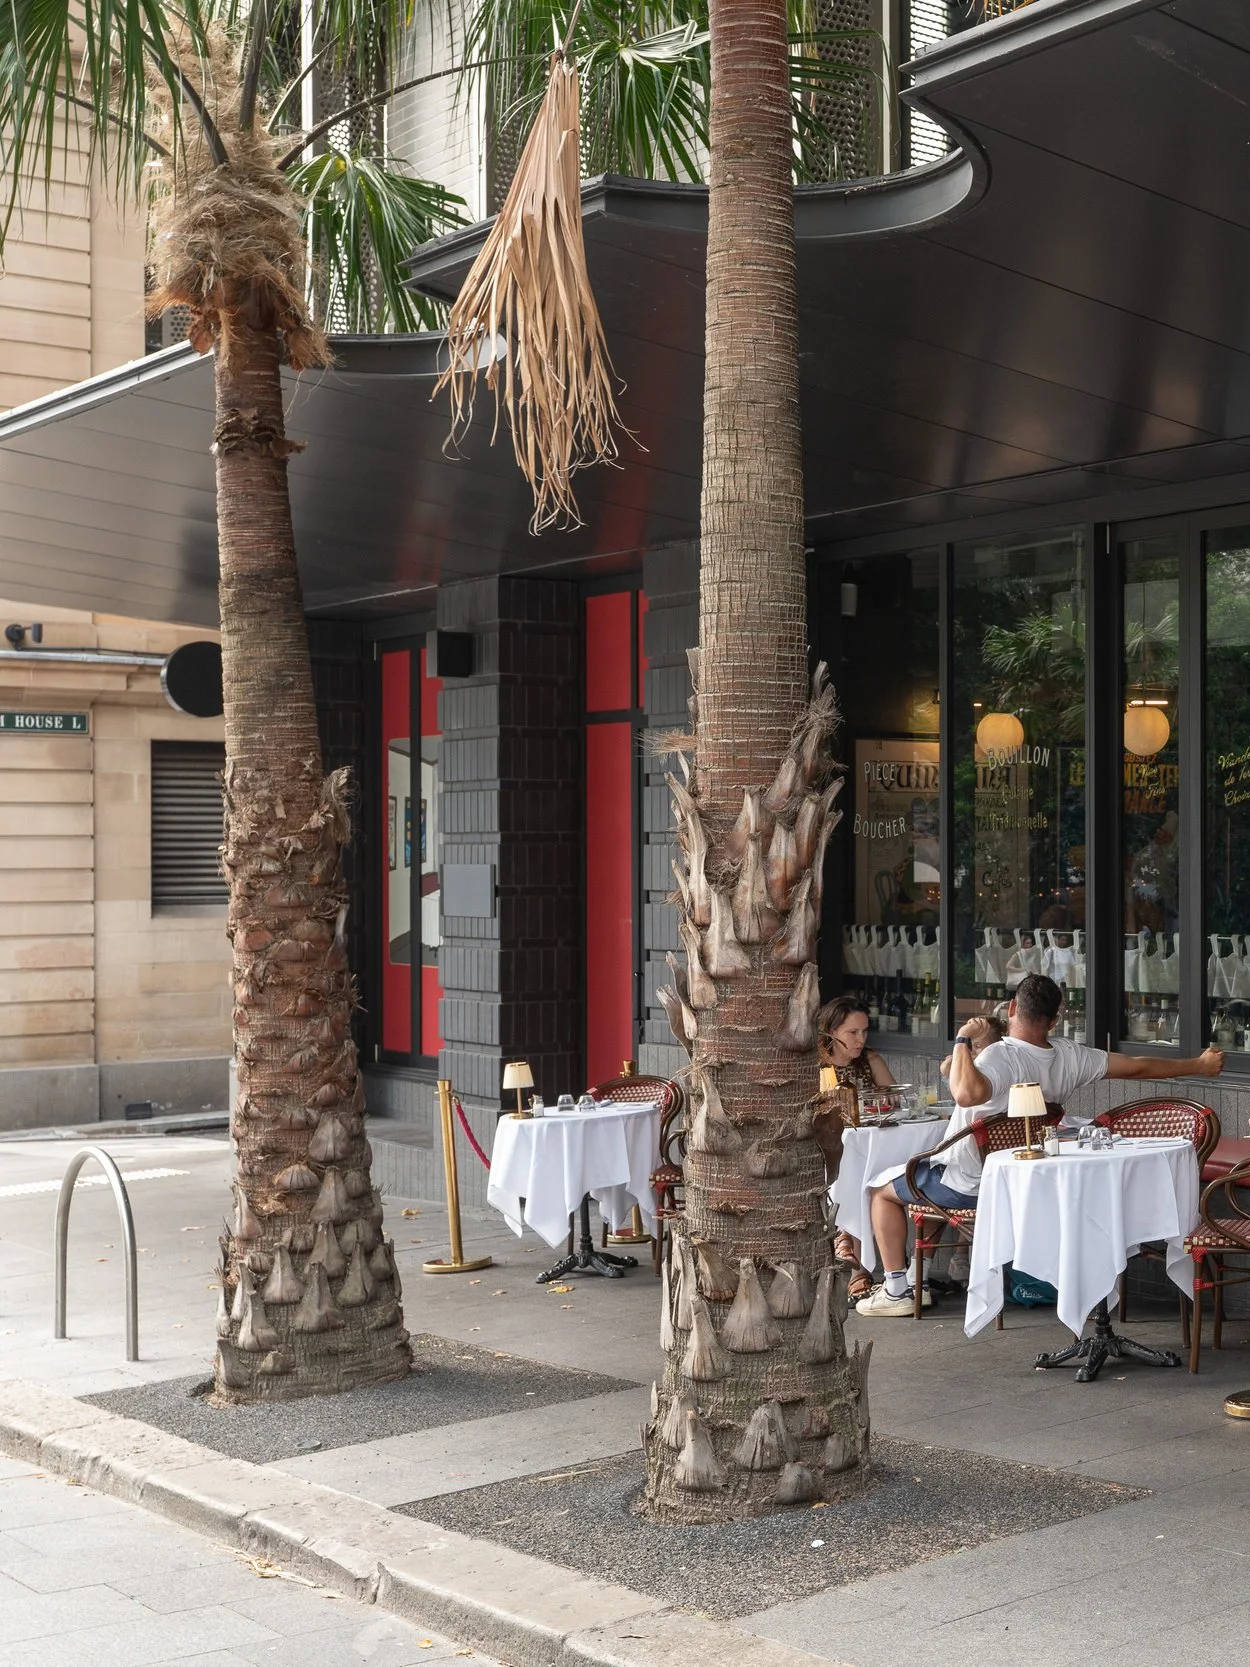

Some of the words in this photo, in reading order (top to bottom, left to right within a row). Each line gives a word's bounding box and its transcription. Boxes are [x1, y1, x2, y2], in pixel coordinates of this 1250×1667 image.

[15, 714, 63, 729] HOUSE
[72, 716, 81, 729] L
[988, 745, 1050, 771] BOUILLON
[853, 813, 906, 839] BOUCHER
